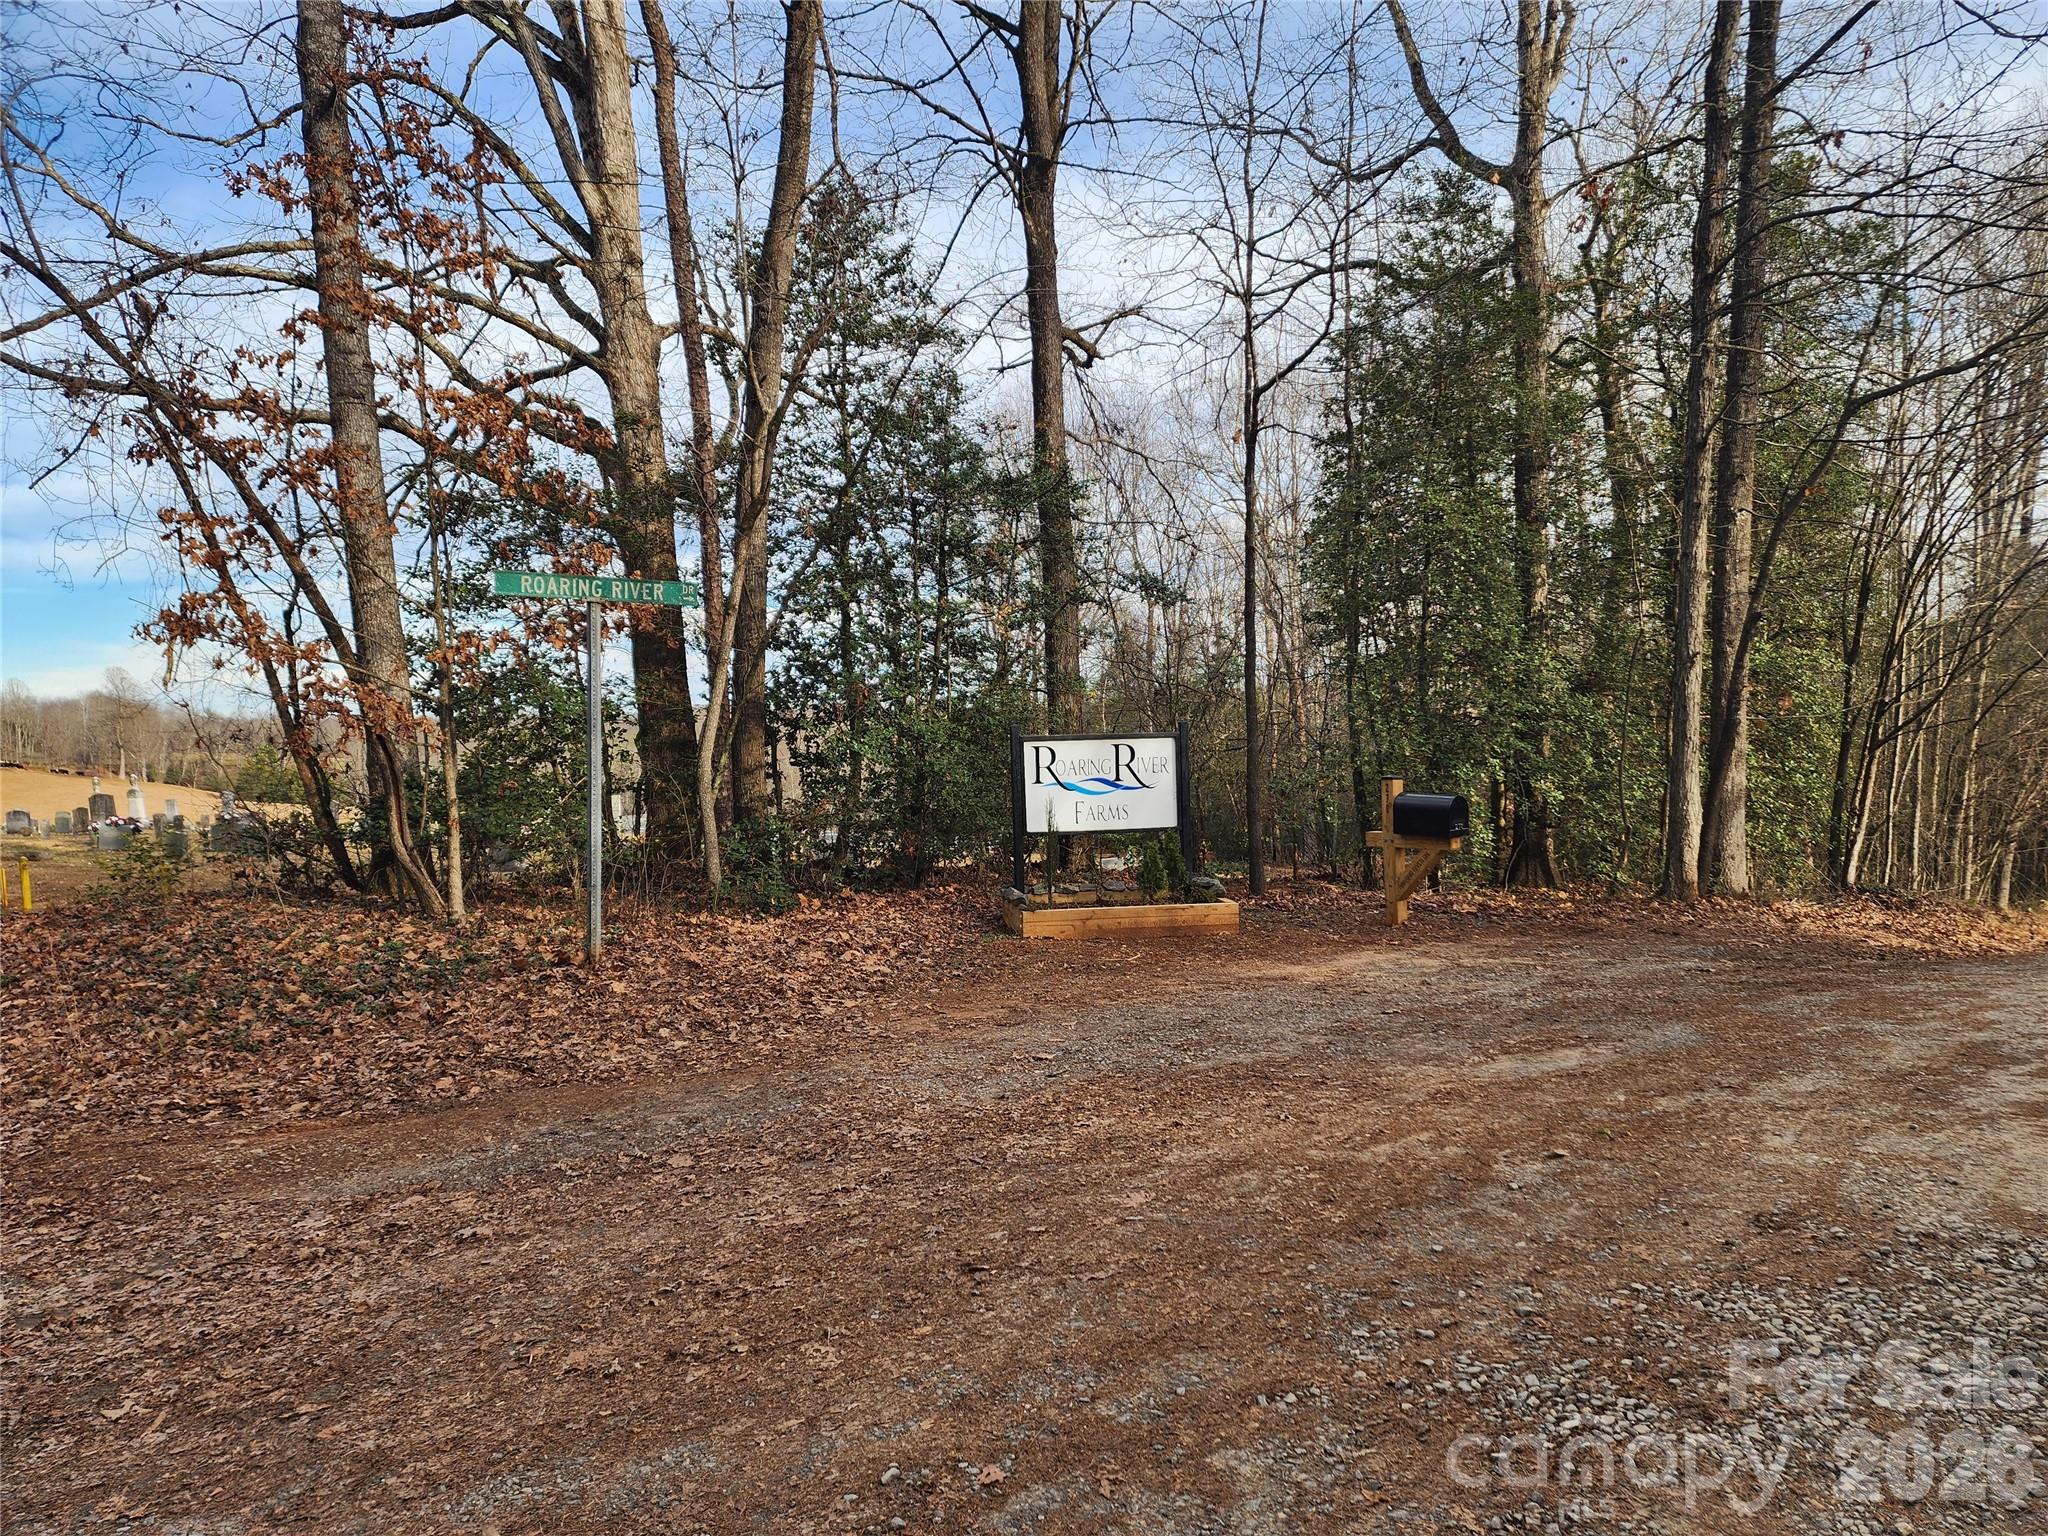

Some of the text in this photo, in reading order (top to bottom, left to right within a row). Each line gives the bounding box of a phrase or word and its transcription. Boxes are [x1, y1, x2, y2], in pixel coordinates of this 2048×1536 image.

[521, 576, 694, 601] ROARING RIVER DR
[1031, 743, 1170, 792] ROARING RIVER
[1075, 800, 1129, 825] FARMS
